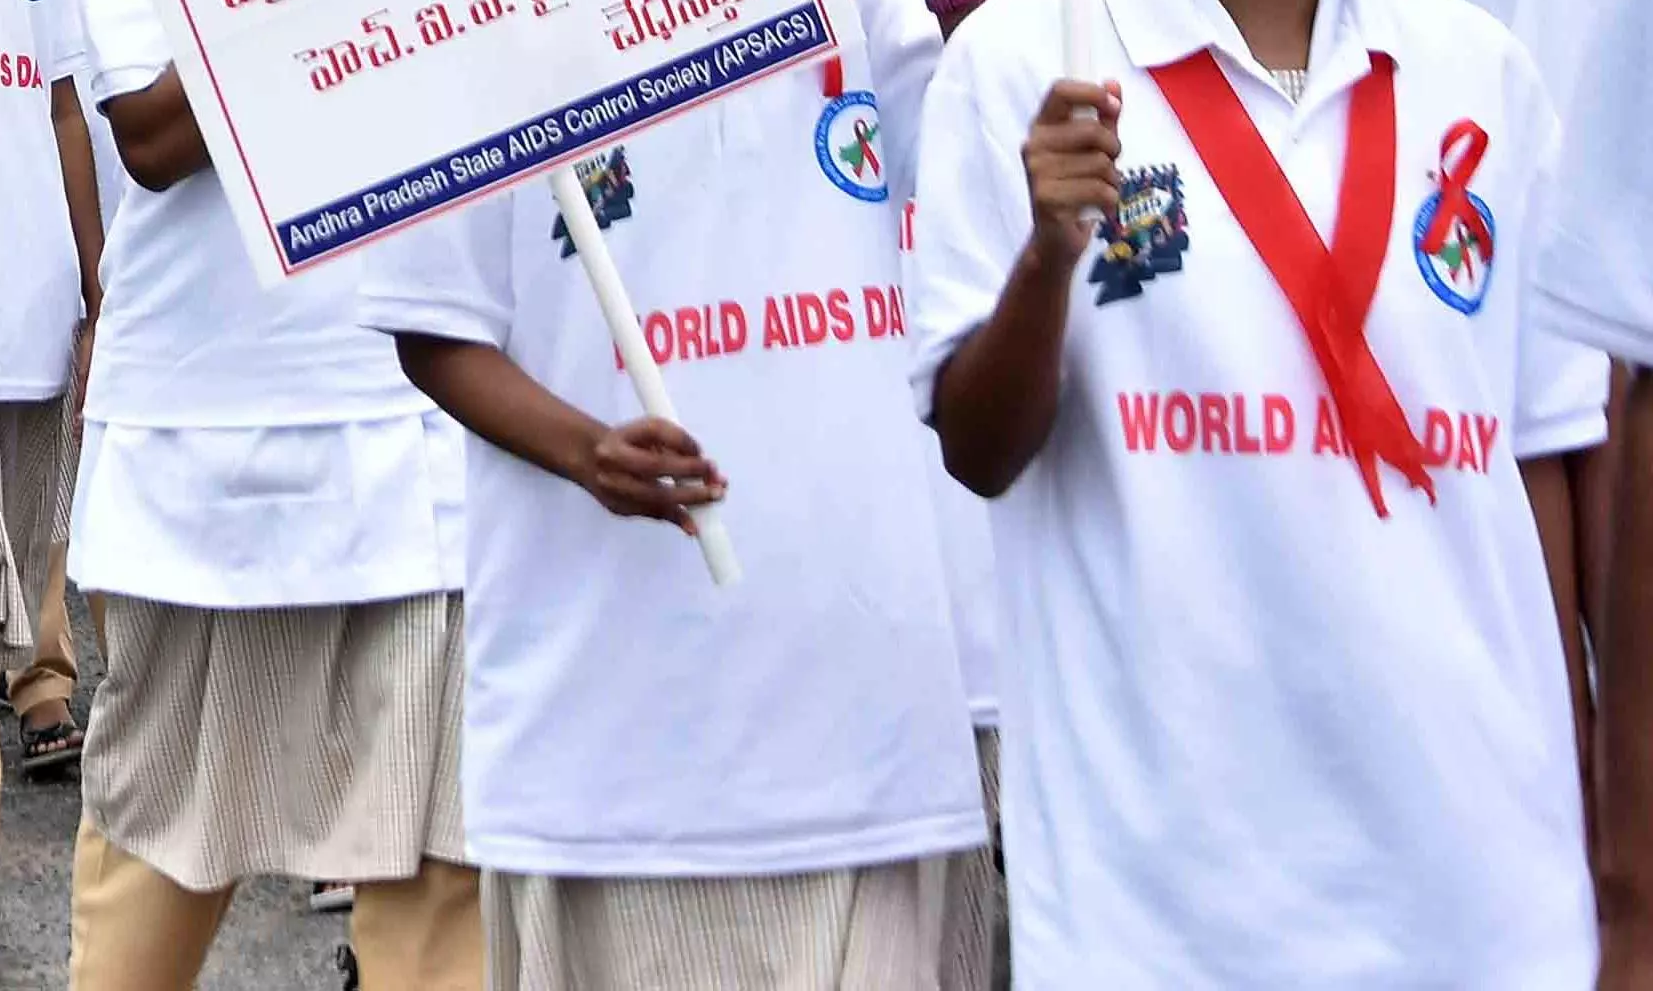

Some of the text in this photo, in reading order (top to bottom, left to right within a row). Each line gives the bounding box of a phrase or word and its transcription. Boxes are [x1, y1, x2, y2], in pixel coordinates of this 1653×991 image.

[17, 55, 43, 88] DA
[291, 11, 816, 249] Andhra Pradesh State AIDS Control Society (APSACS)
[763, 286, 855, 349] AIDS
[862, 283, 905, 339] DA
[1118, 392, 1297, 454] WORLD
[1422, 407, 1501, 475] DAY
